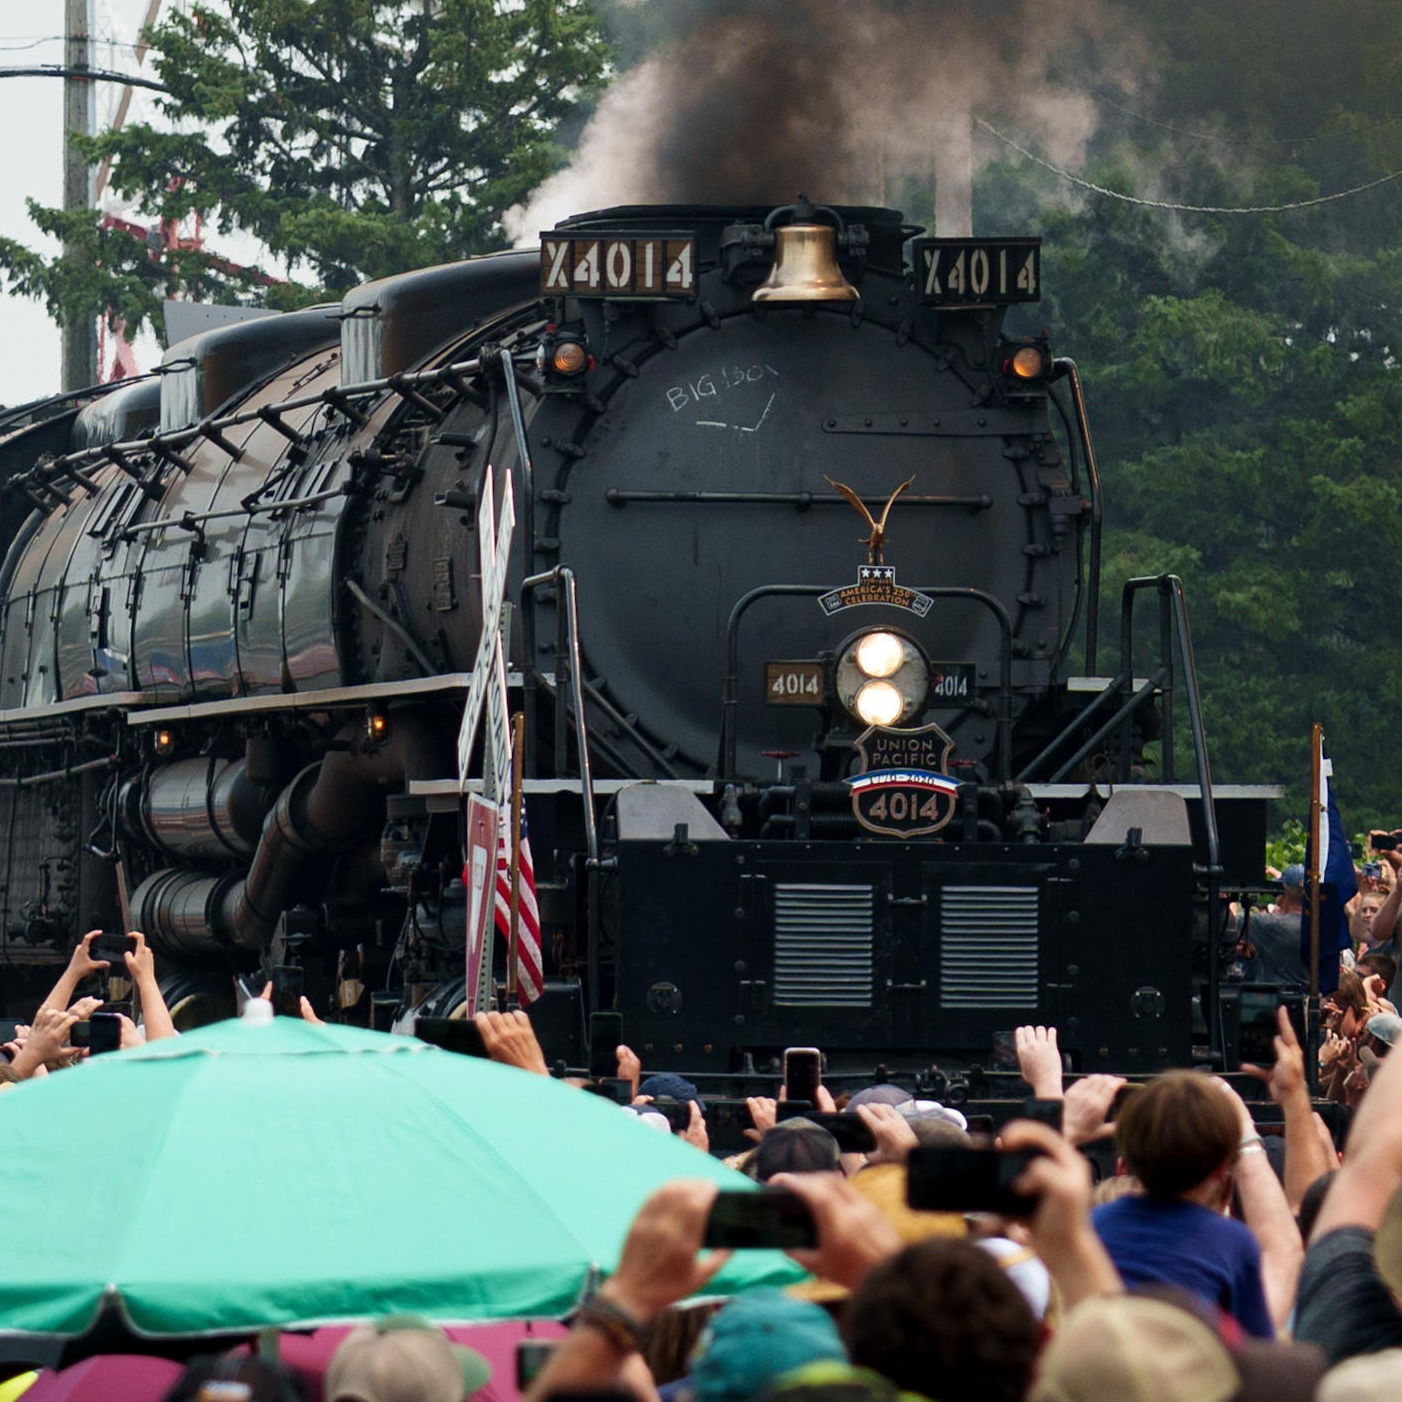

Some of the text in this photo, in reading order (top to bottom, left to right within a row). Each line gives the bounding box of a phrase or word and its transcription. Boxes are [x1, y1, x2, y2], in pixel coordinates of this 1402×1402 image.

[545, 241, 694, 289] X4014
[923, 248, 1037, 295] X4014
[666, 373, 717, 412] BIG
[840, 585, 891, 598] AMERICA'S
[844, 594, 910, 607] CELEBRATION
[771, 674, 819, 695] 4014
[934, 674, 968, 697] 4014
[877, 739, 933, 752] UNION
[872, 752, 937, 767] PACIFIC
[867, 792, 939, 821] 4014
